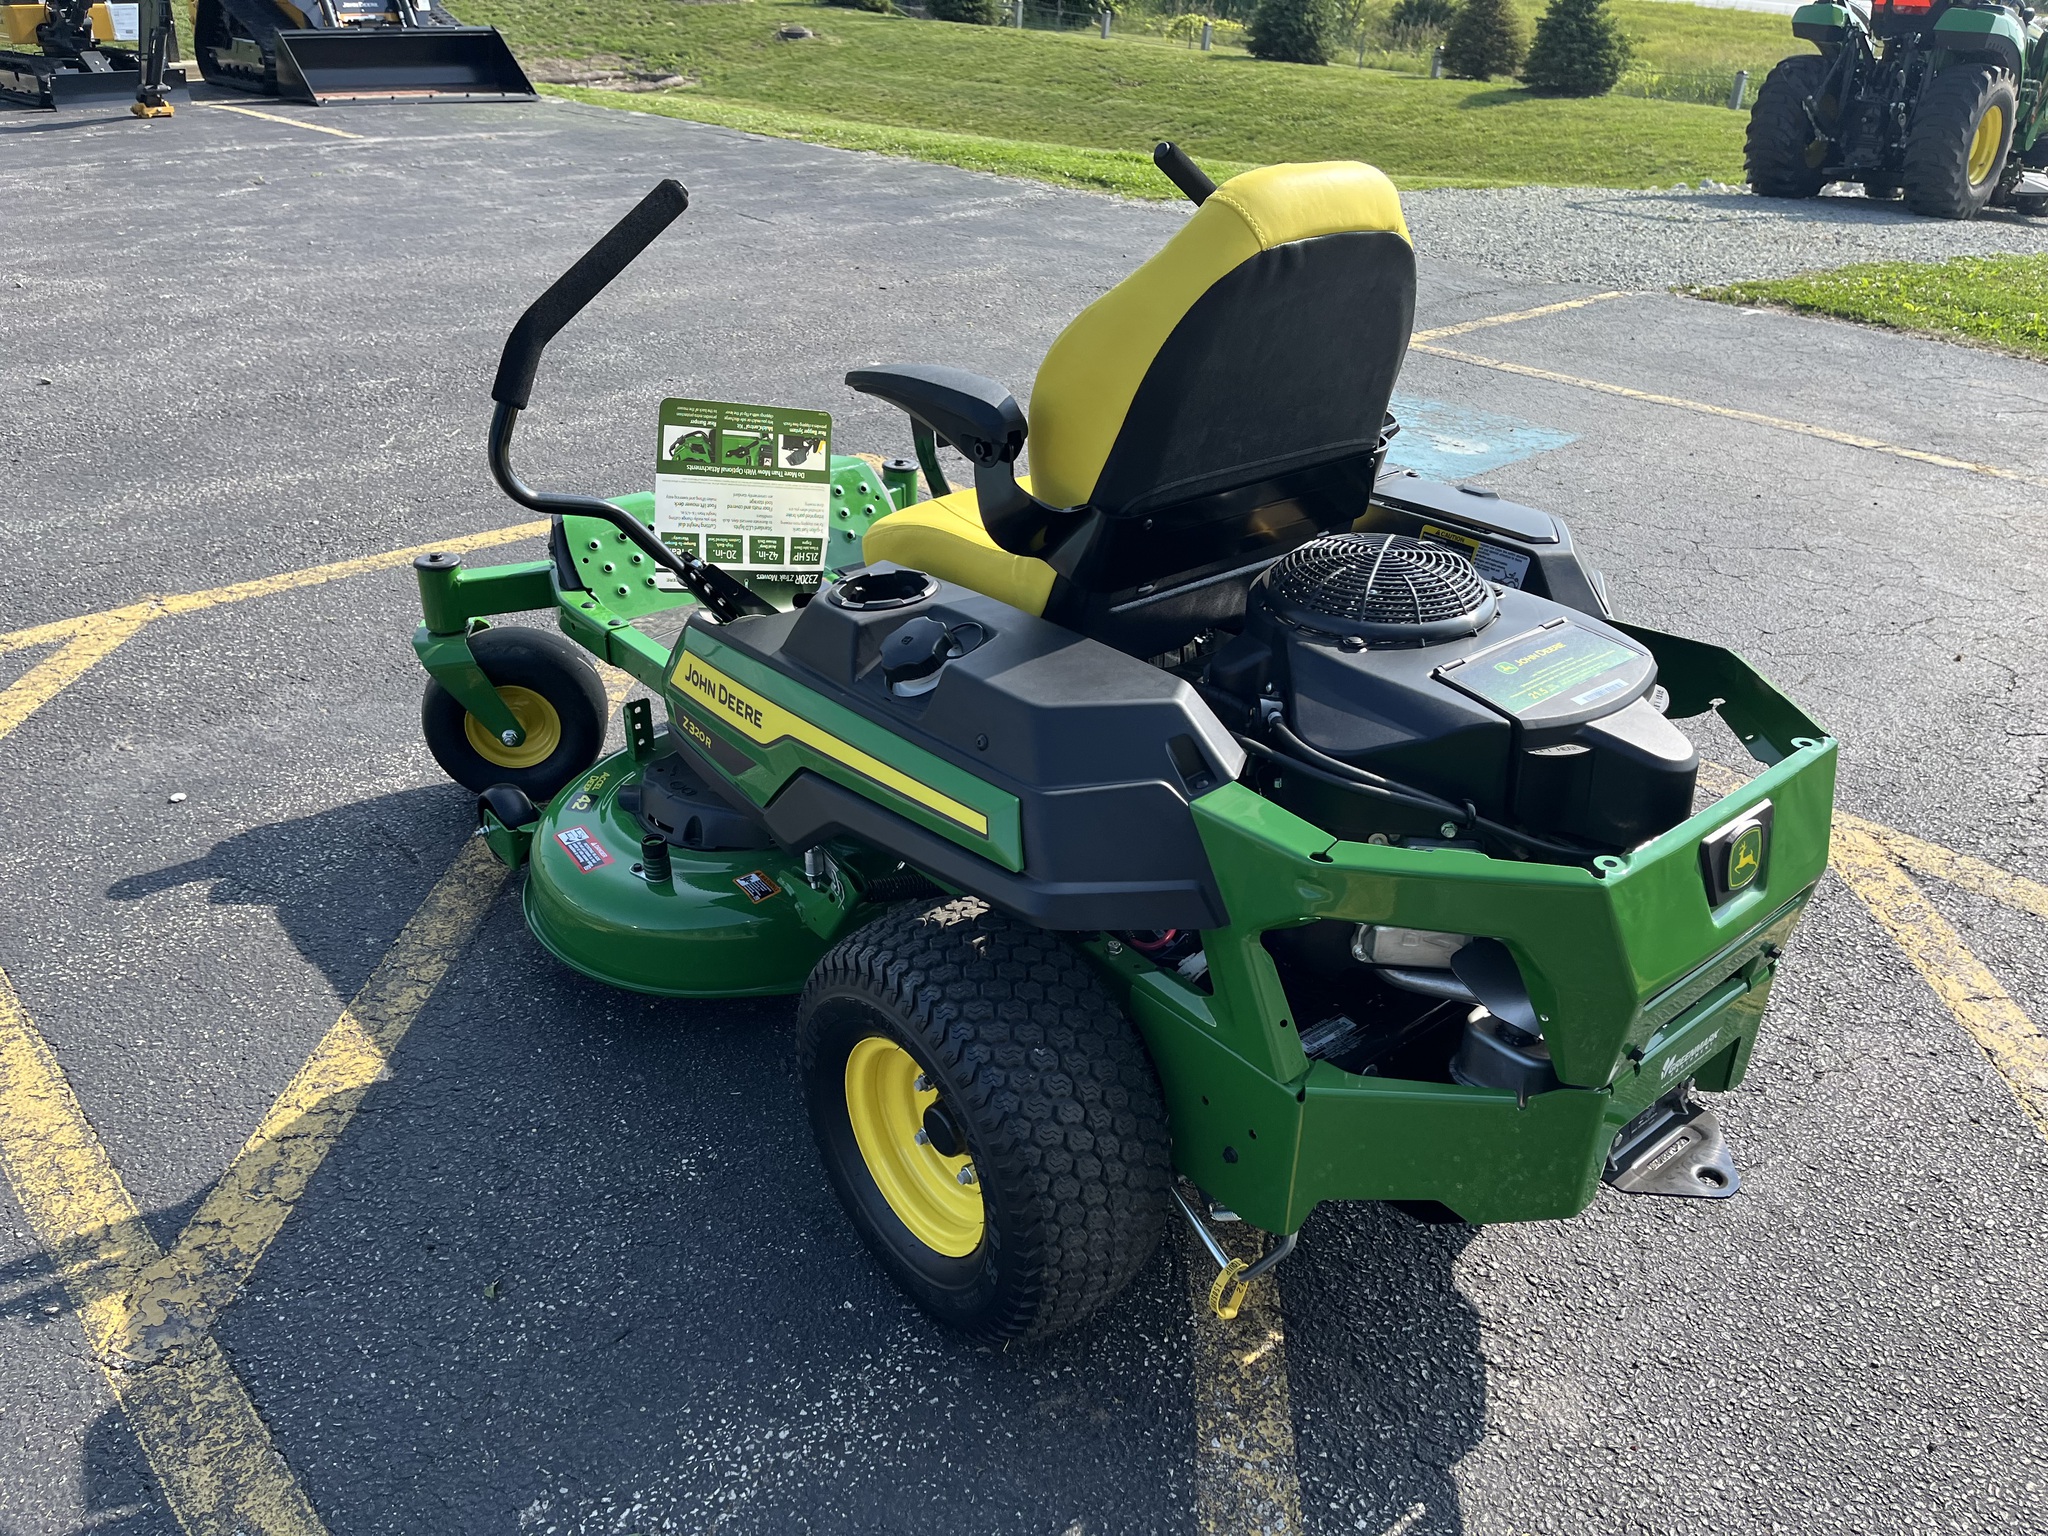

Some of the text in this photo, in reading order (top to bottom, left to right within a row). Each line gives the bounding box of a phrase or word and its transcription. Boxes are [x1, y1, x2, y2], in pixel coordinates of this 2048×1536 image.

[686, 465, 720, 473] Attachments
[1440, 530, 1465, 543] CAUTION
[713, 550, 737, 560] 20-in.
[756, 551, 778, 560] 42-in.
[795, 574, 818, 584] Z320R
[1516, 650, 1540, 667] JOHN
[1537, 642, 1567, 660] DEERE
[685, 664, 763, 729] JOHN DEERE
[1528, 686, 1550, 700] 21.5
[682, 716, 712, 748] Z320R
[583, 776, 600, 792] DEEP
[592, 772, 610, 790] ACCEL
[572, 794, 591, 810] 42
